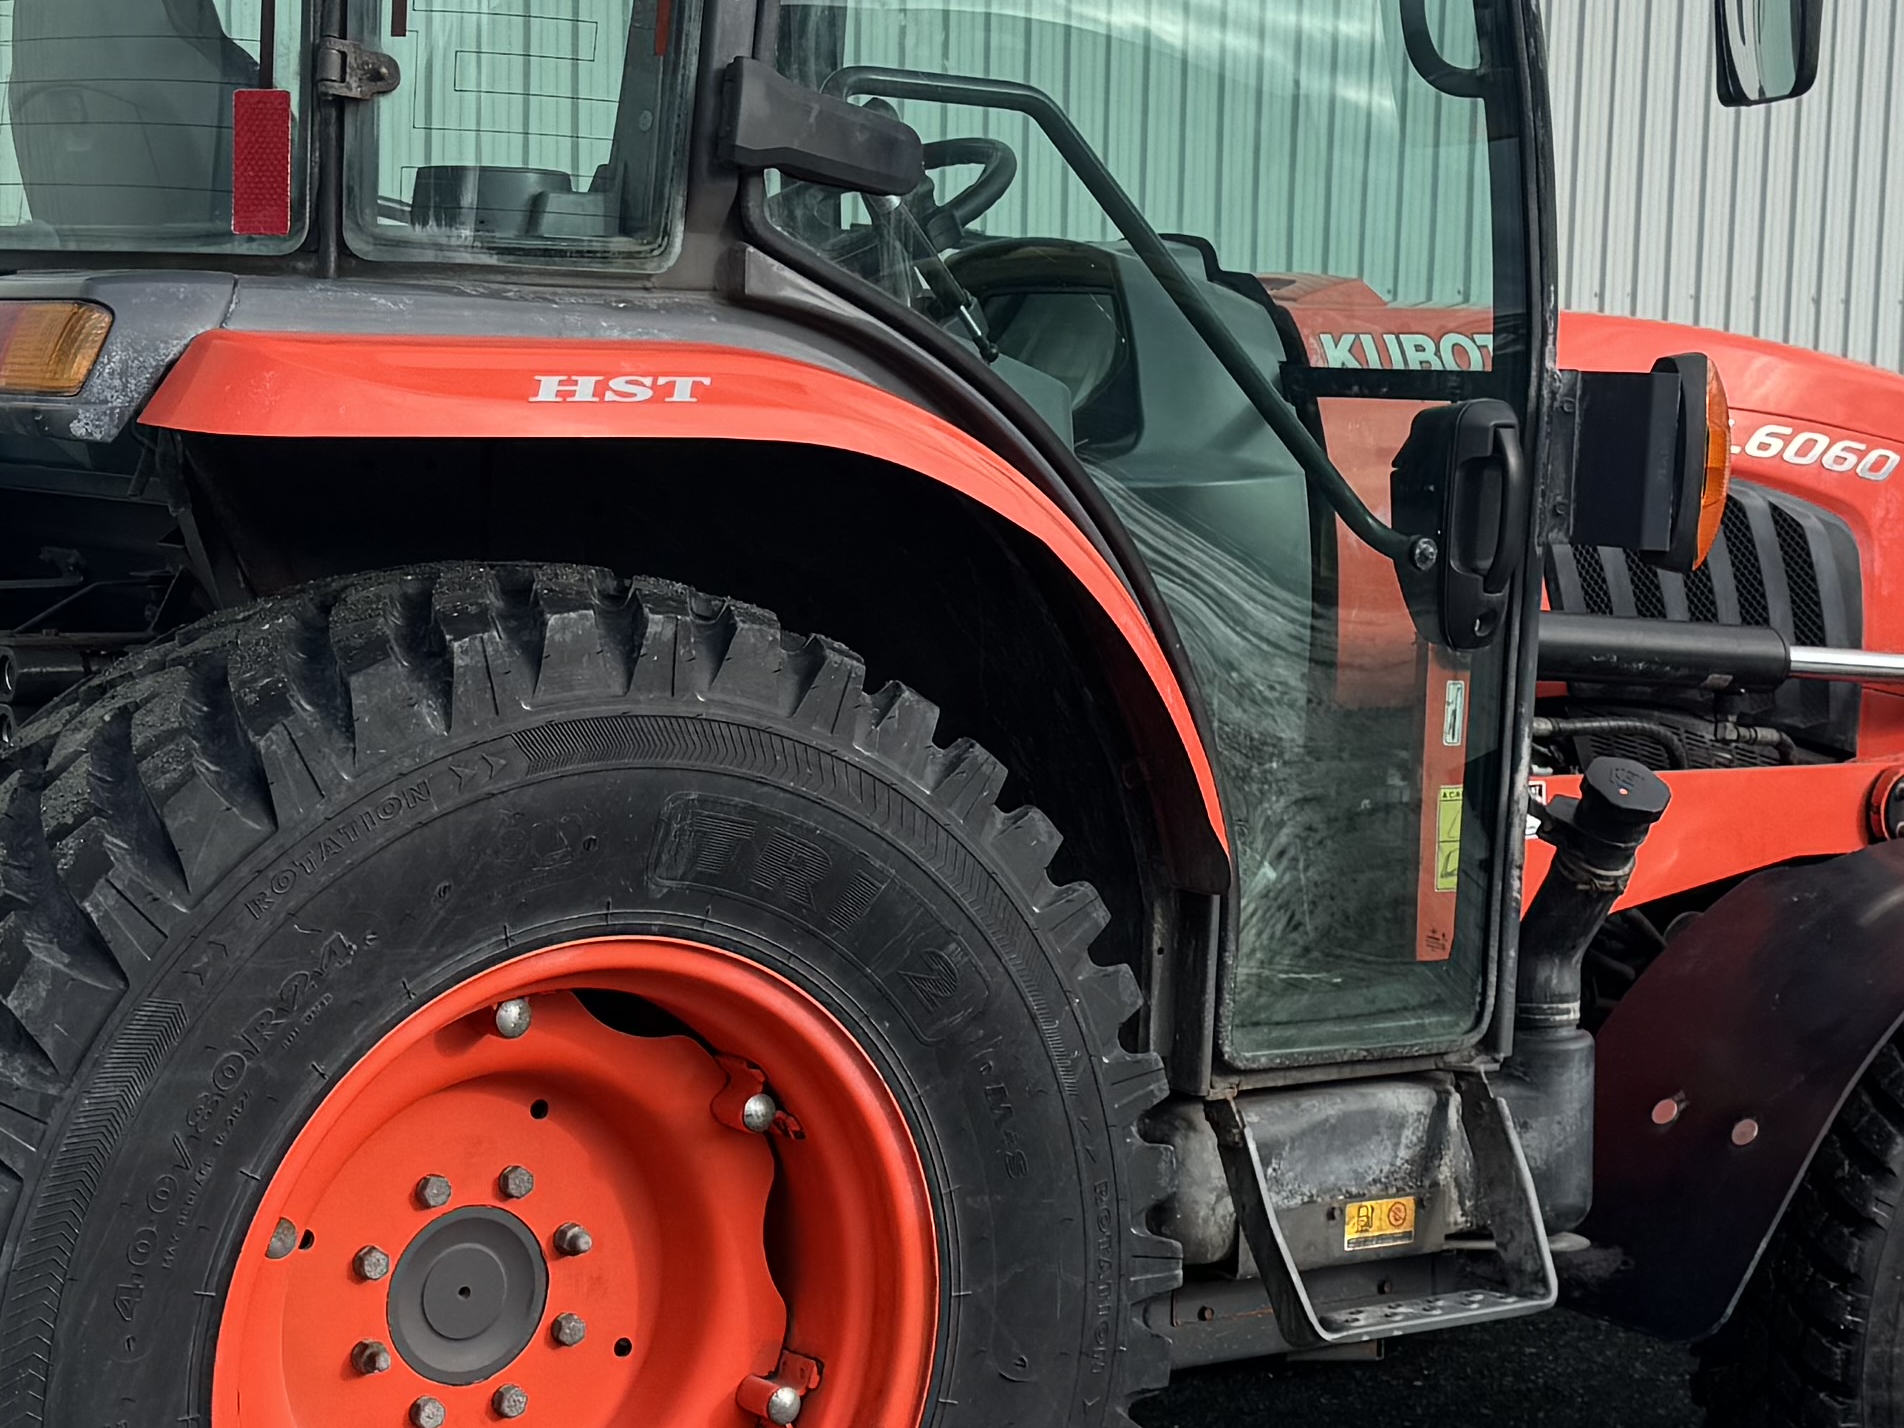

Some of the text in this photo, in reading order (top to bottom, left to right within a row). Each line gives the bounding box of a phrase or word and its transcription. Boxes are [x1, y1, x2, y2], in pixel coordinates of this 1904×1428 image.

[528, 375, 712, 403] HST
[244, 778, 437, 922] ROTATION
[690, 812, 884, 933] TRI
[1091, 1179, 1114, 1374] ROTATION
